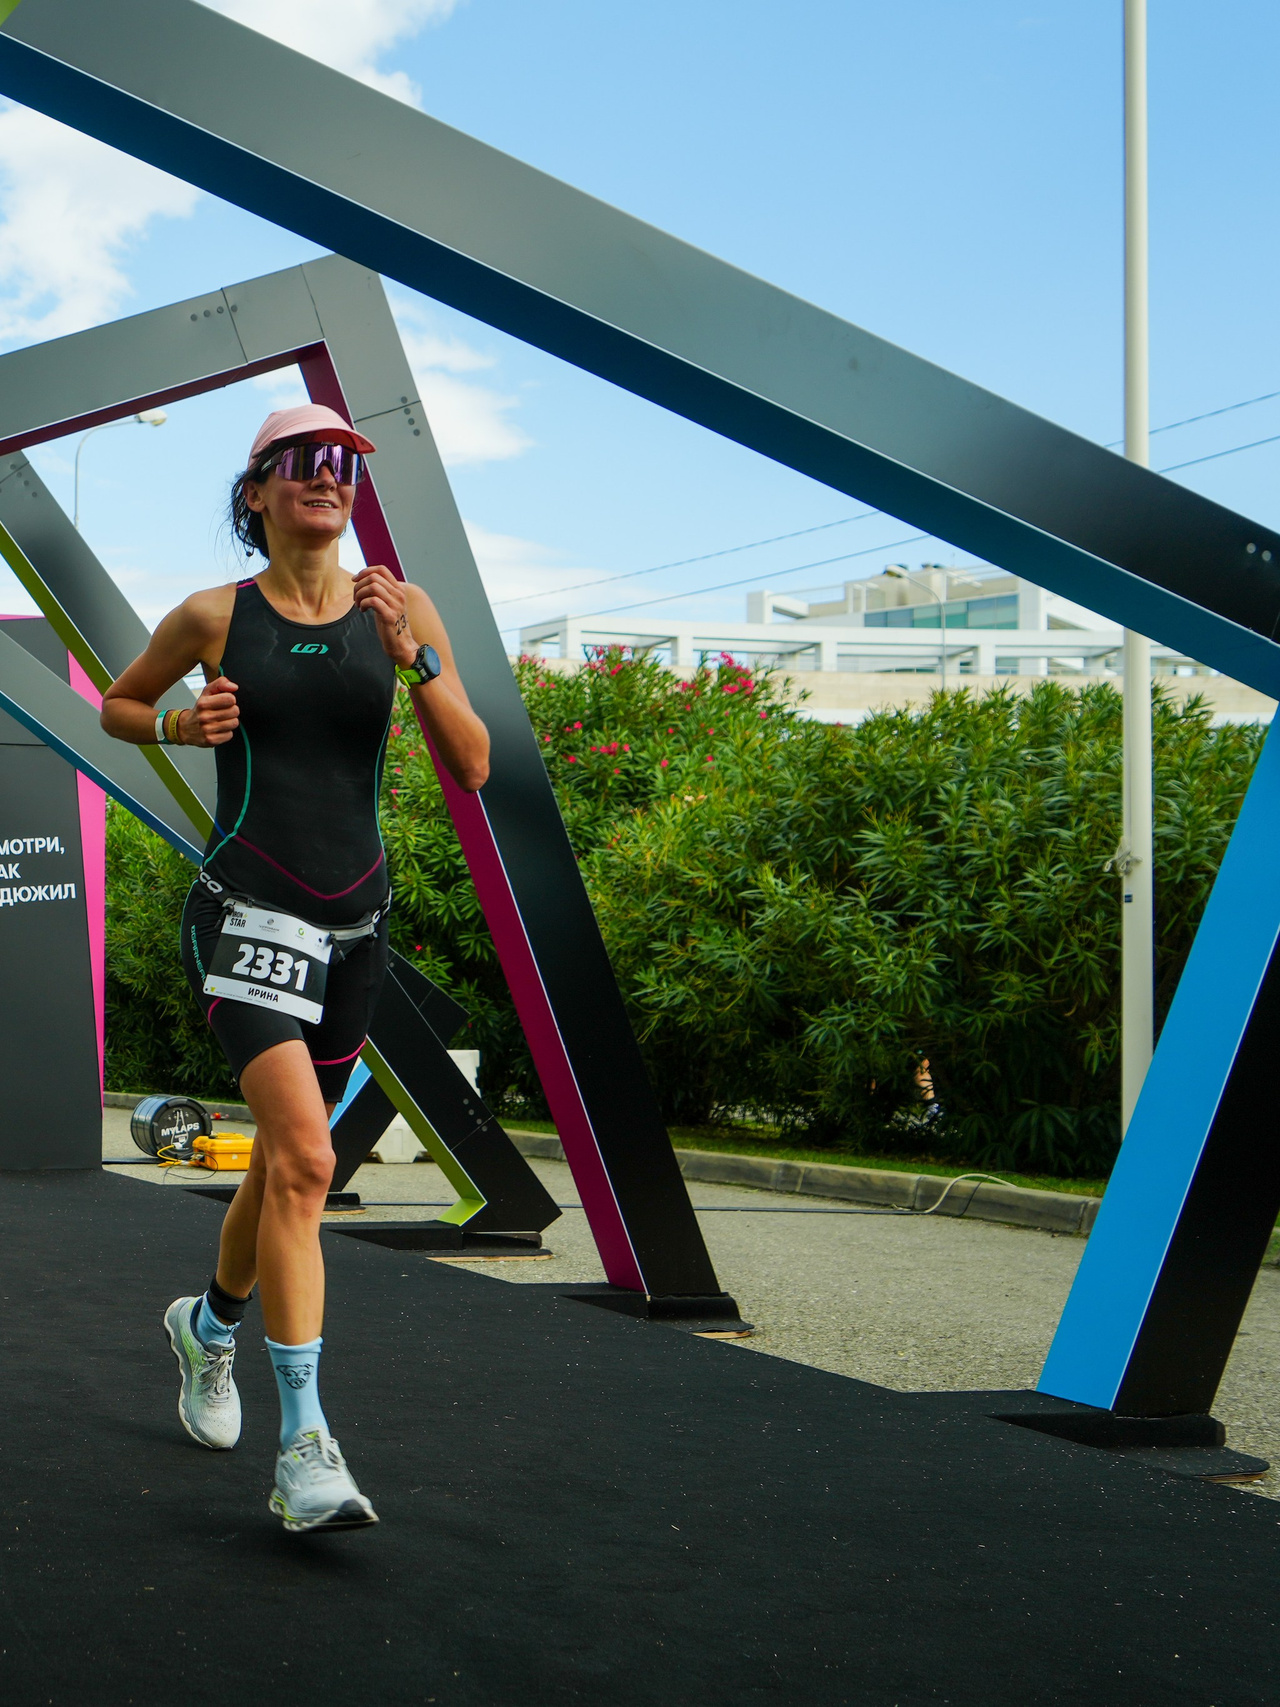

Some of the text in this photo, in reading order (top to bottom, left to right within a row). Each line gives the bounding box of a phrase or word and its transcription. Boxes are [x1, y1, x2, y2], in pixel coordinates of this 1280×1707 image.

[394, 614, 408, 636] 23
[229, 917, 247, 928] STAR
[231, 943, 310, 992] 2331
[247, 987, 280, 1003] ИРИНА
[161, 1122, 200, 1137] MYLAPS
